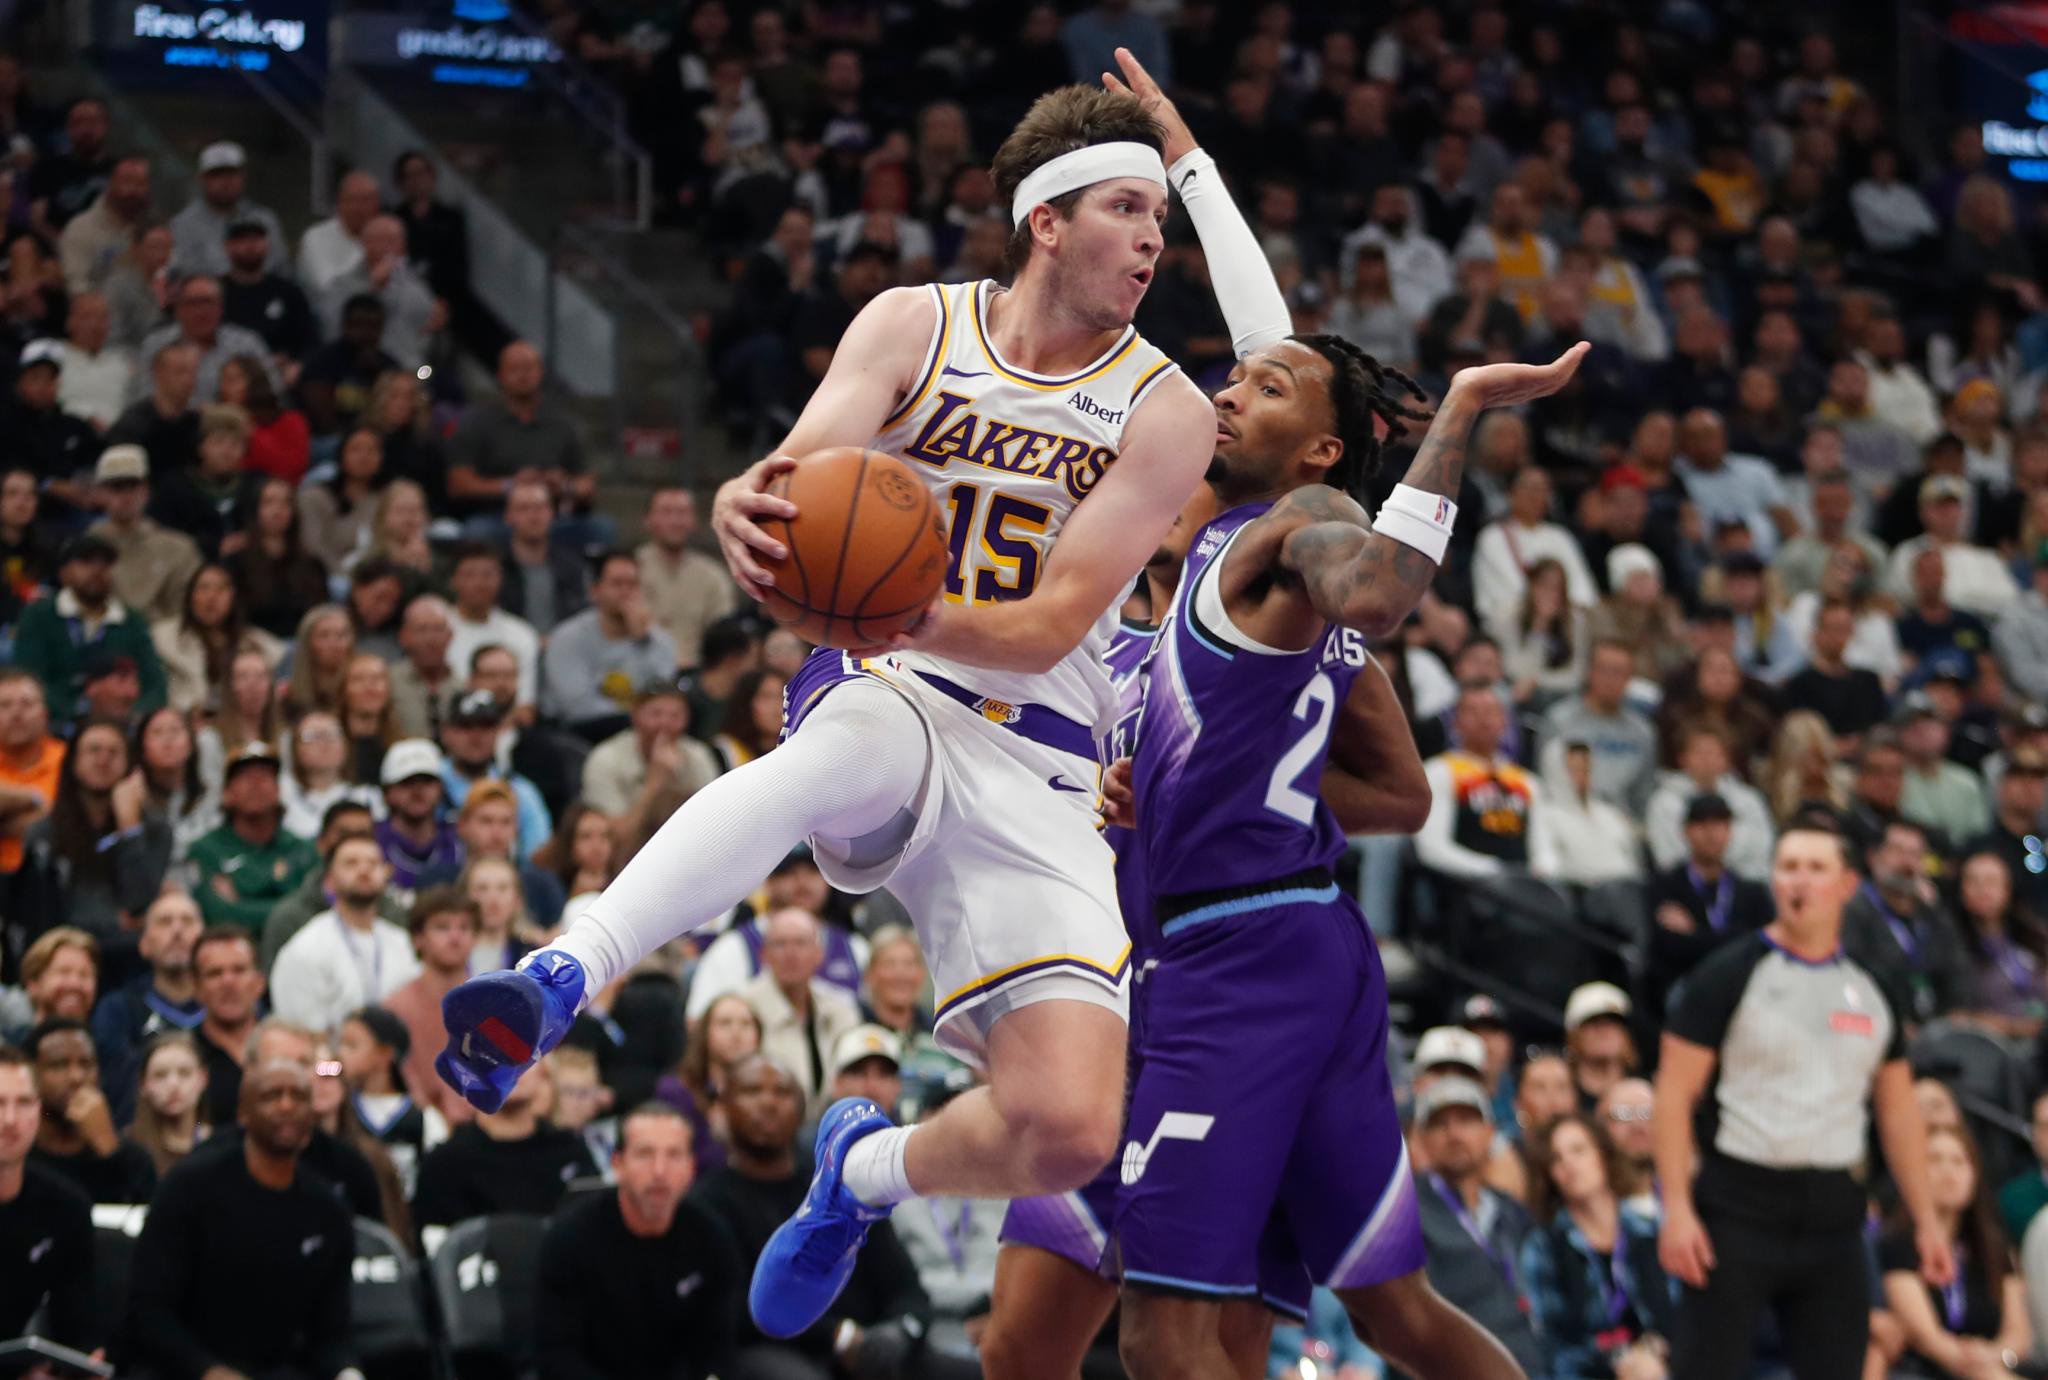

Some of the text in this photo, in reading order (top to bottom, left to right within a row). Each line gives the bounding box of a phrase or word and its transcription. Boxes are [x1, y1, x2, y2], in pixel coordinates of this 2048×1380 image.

[904, 390, 1118, 502] LAKERS
[1067, 391, 1125, 425] Albert
[944, 482, 1053, 607] 15
[1263, 670, 1336, 827] 2
